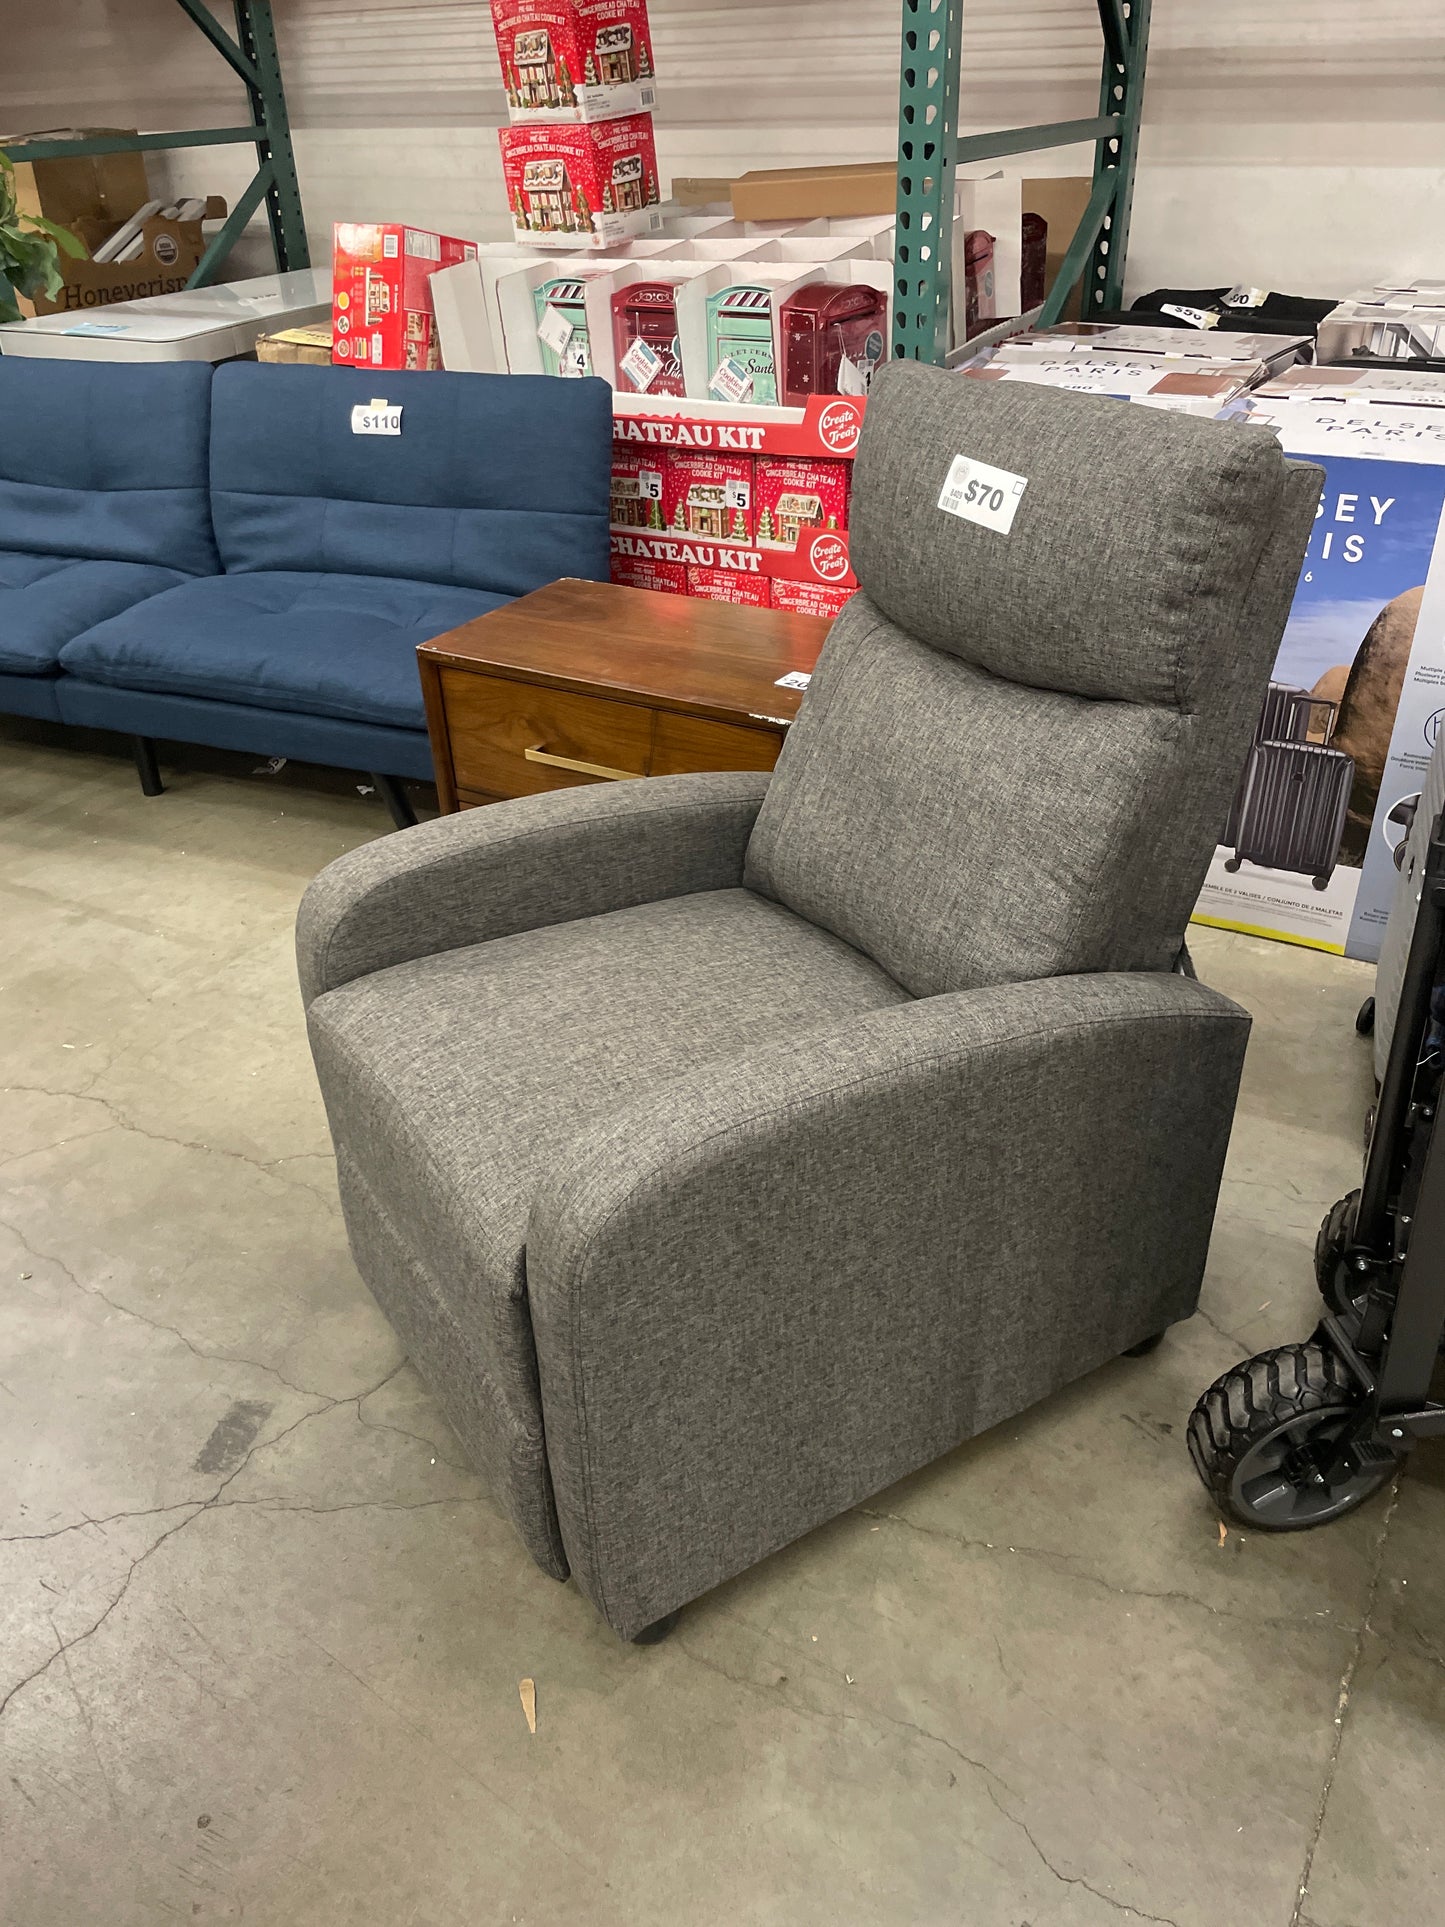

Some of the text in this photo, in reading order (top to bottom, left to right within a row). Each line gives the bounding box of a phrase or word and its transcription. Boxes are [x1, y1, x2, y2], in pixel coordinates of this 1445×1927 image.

[1040, 360, 1164, 370] DELSEY
[1045, 366, 1142, 376] PARIS
[719, 368, 743, 391] Cookies
[363, 415, 399, 429] $110
[823, 410, 854, 429] Create
[717, 426, 765, 449] KIT
[829, 424, 856, 444] Treat
[692, 469, 712, 478] COOKIE
[714, 464, 742, 476] CHATEAU
[783, 478, 816, 489] COOKIE KIT
[806, 472, 836, 486] CHATEAU
[732, 492, 746, 507] $5
[964, 478, 1004, 511] $70
[814, 544, 842, 558] Create
[1304, 532, 1365, 562] IS
[718, 549, 762, 572] KIT
[820, 556, 844, 573] Treat
[711, 593, 731, 602] COOKIE
[732, 589, 759, 602] CHATEAU
[796, 606, 829, 618] COOKIE KIT
[1267, 896, 1300, 907] CONJUNTO
[1316, 907, 1343, 916] MALETAS
